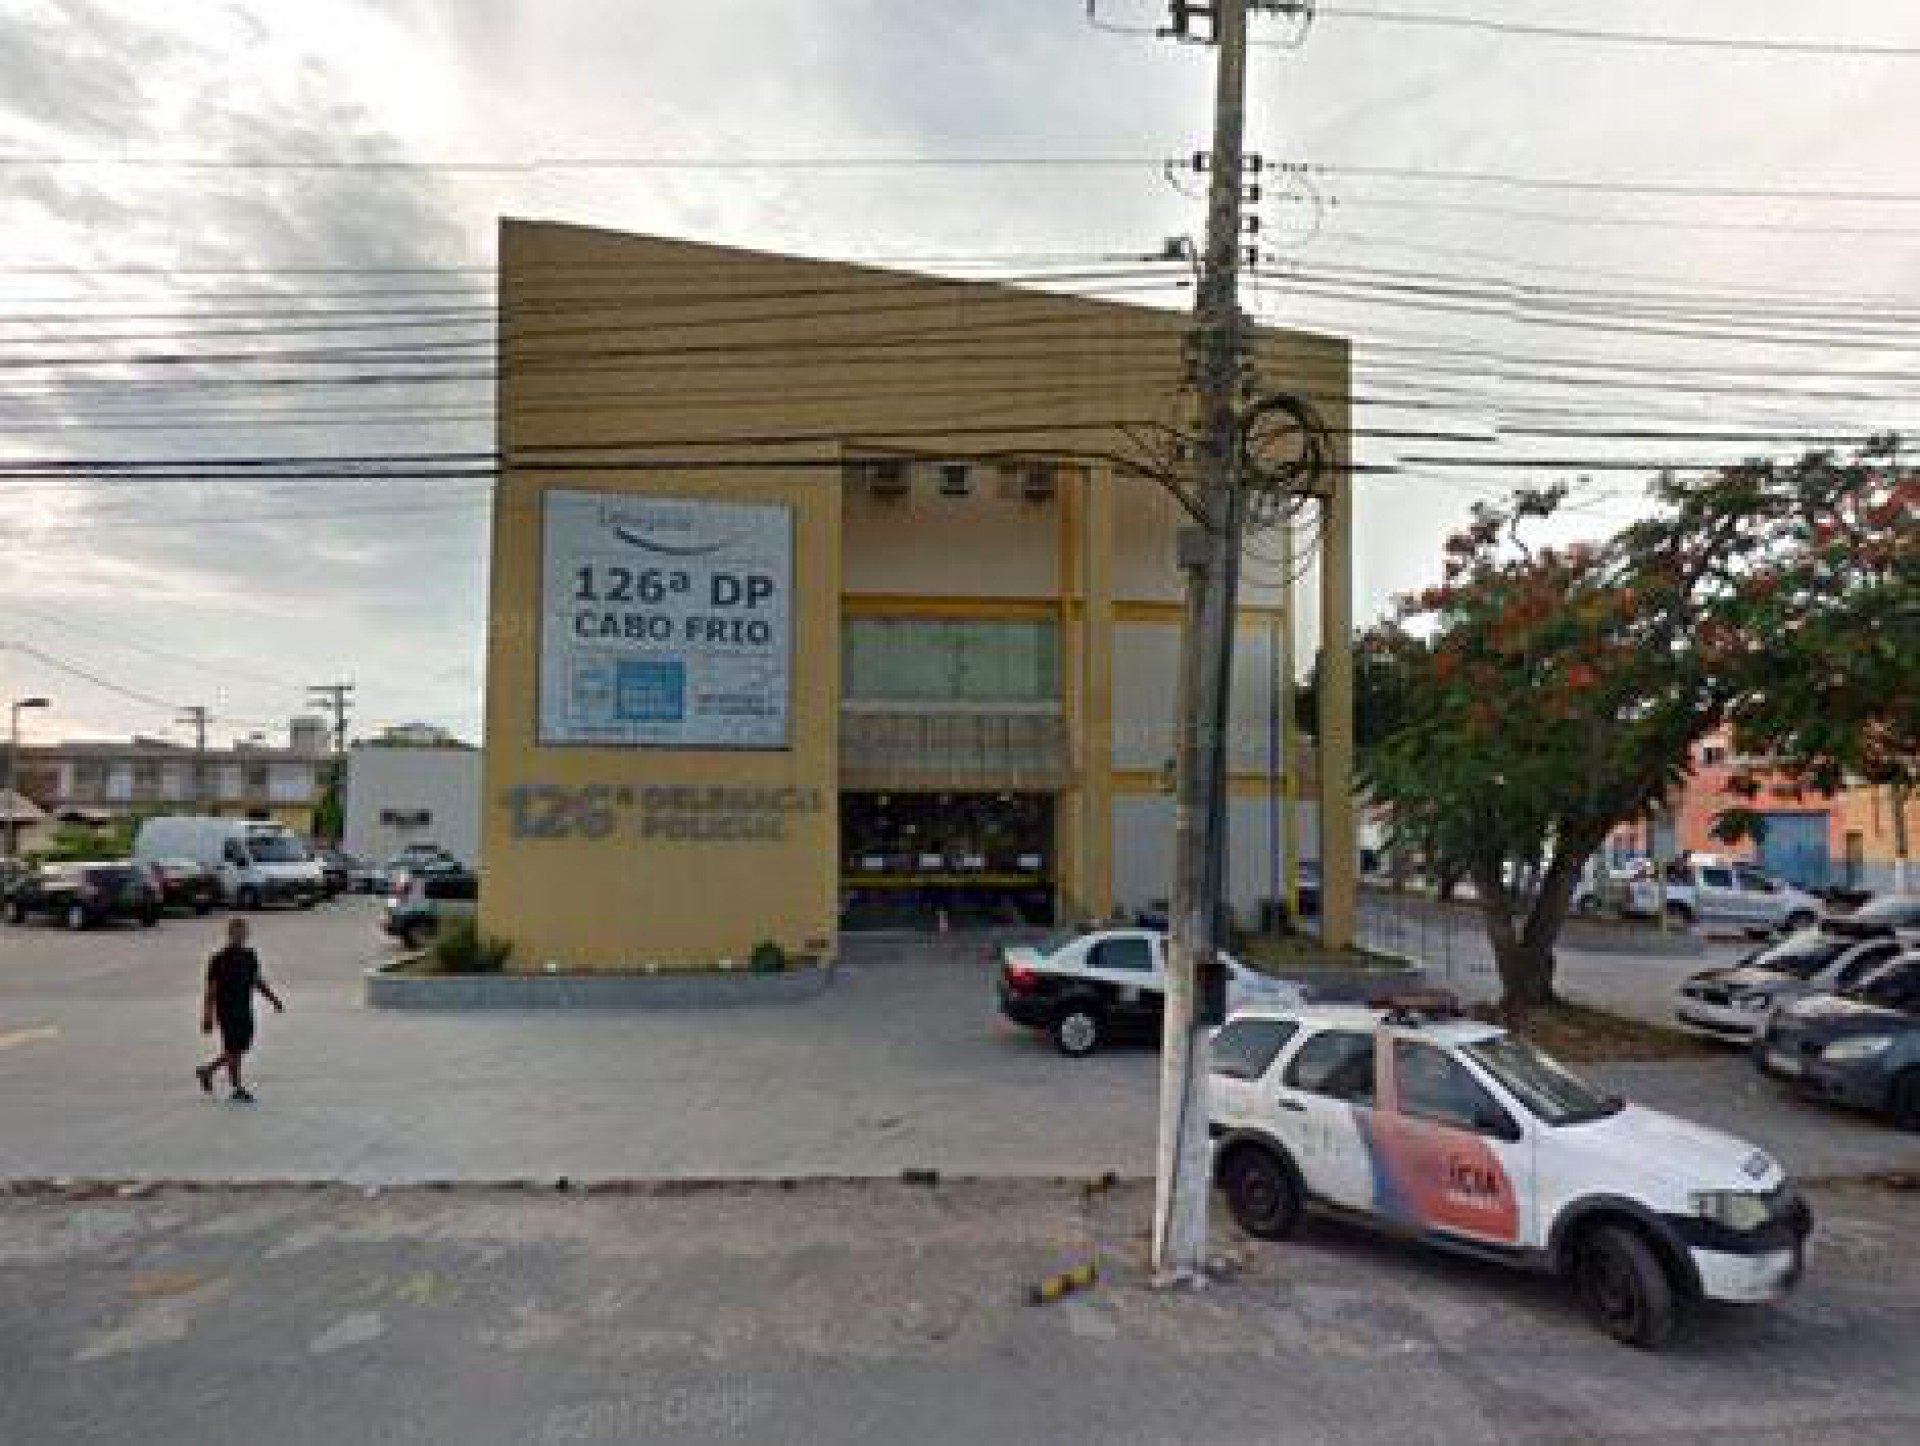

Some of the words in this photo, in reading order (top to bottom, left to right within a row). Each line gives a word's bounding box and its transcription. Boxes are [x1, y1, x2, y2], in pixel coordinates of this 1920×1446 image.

[575, 565, 690, 603] 126ª
[711, 574, 773, 608] DP
[575, 611, 671, 640] CABO
[685, 617, 770, 645] FRIO
